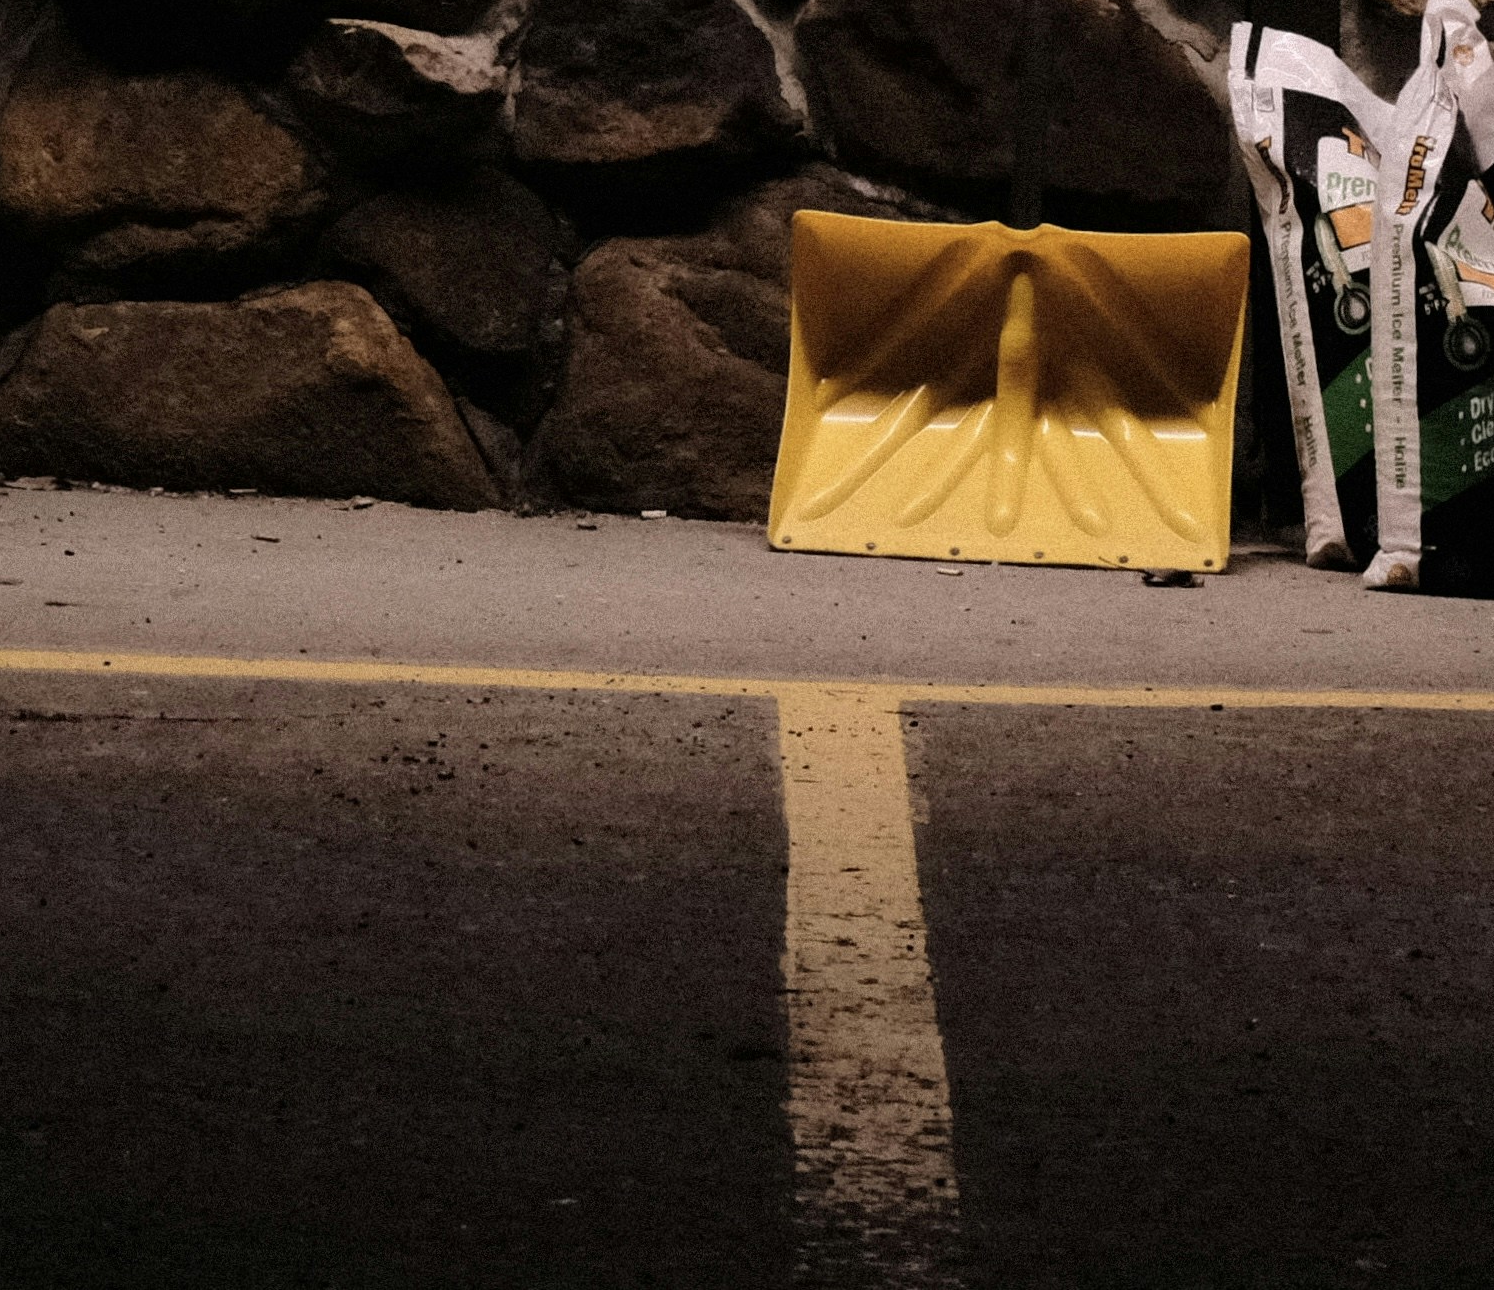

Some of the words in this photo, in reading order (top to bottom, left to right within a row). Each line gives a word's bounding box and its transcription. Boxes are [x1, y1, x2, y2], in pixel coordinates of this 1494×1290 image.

[1391, 223, 1404, 306] Premium
[1391, 313, 1404, 341] Ice
[1391, 346, 1405, 404] Melter
[1470, 392, 1494, 419] Dry
